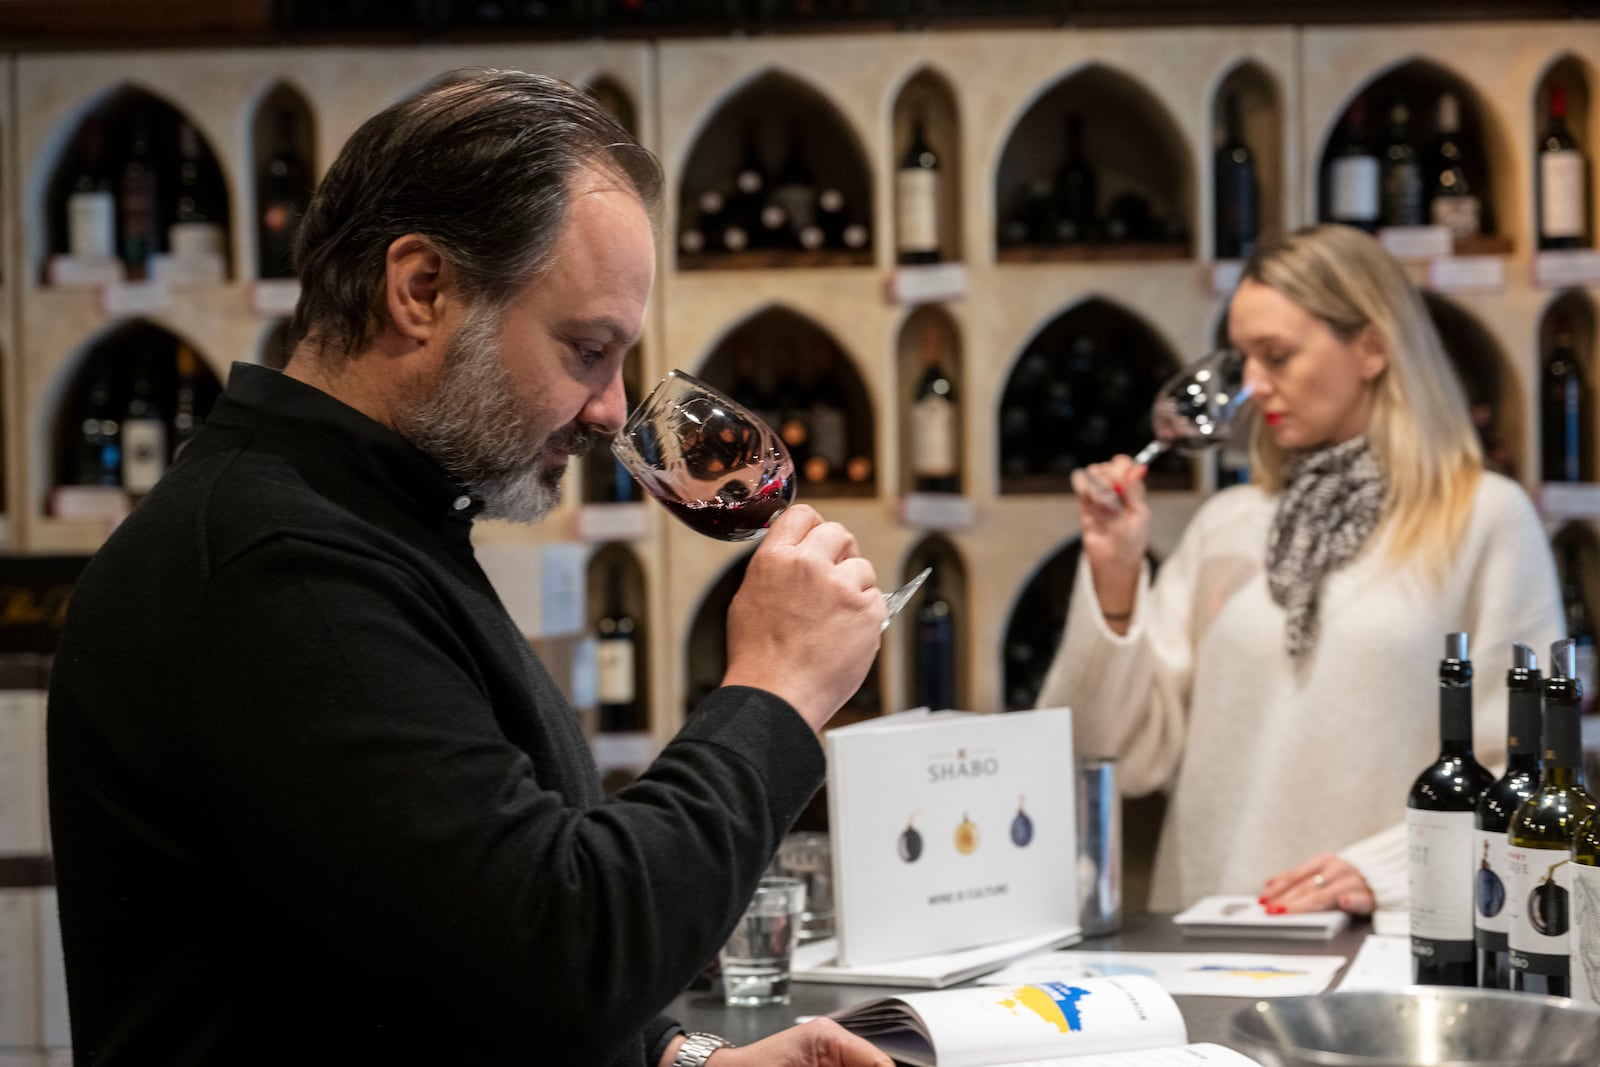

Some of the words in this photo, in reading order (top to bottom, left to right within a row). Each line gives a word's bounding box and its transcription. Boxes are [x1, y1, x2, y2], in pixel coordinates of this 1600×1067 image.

[928, 758, 998, 783] SHABO
[928, 893, 953, 905] WINE
[967, 883, 1008, 901] CULTURE
